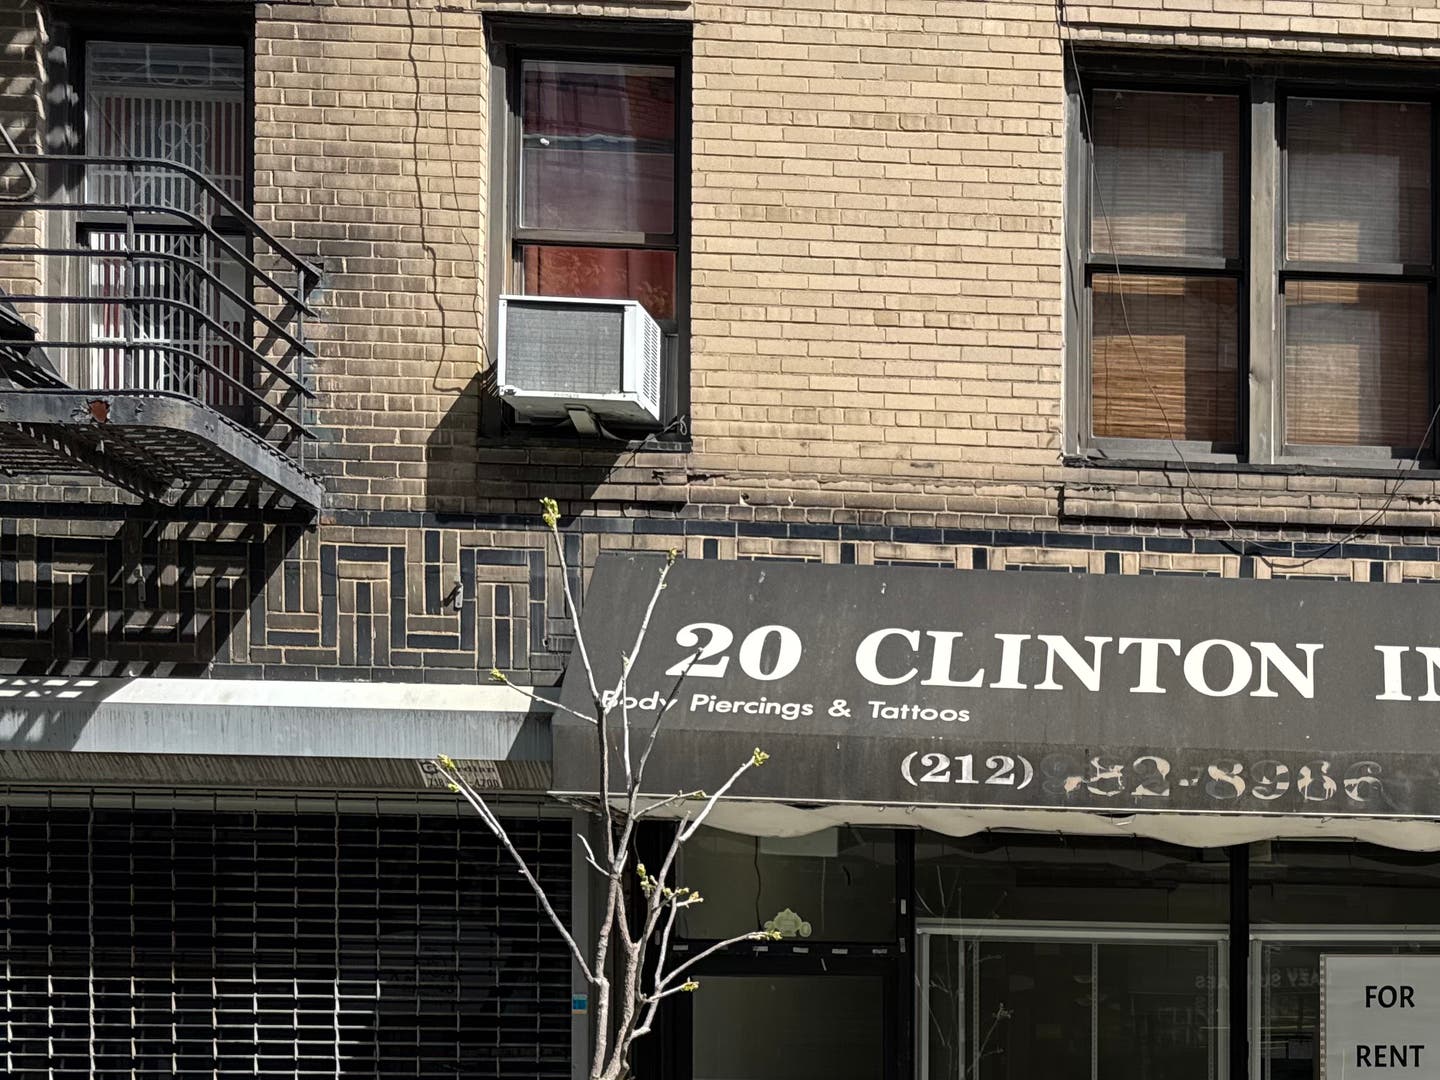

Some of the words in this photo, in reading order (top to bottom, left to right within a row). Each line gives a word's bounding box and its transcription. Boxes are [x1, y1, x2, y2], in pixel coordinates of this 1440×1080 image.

[666, 622, 802, 681] 20
[855, 627, 1323, 700] CLINTON
[689, 693, 814, 721] Piercings
[828, 698, 852, 718] &
[868, 700, 970, 723] Tattoos
[901, 751, 1034, 788] (212)
[1365, 985, 1415, 1009] FOR
[1356, 1044, 1425, 1068] RENT
